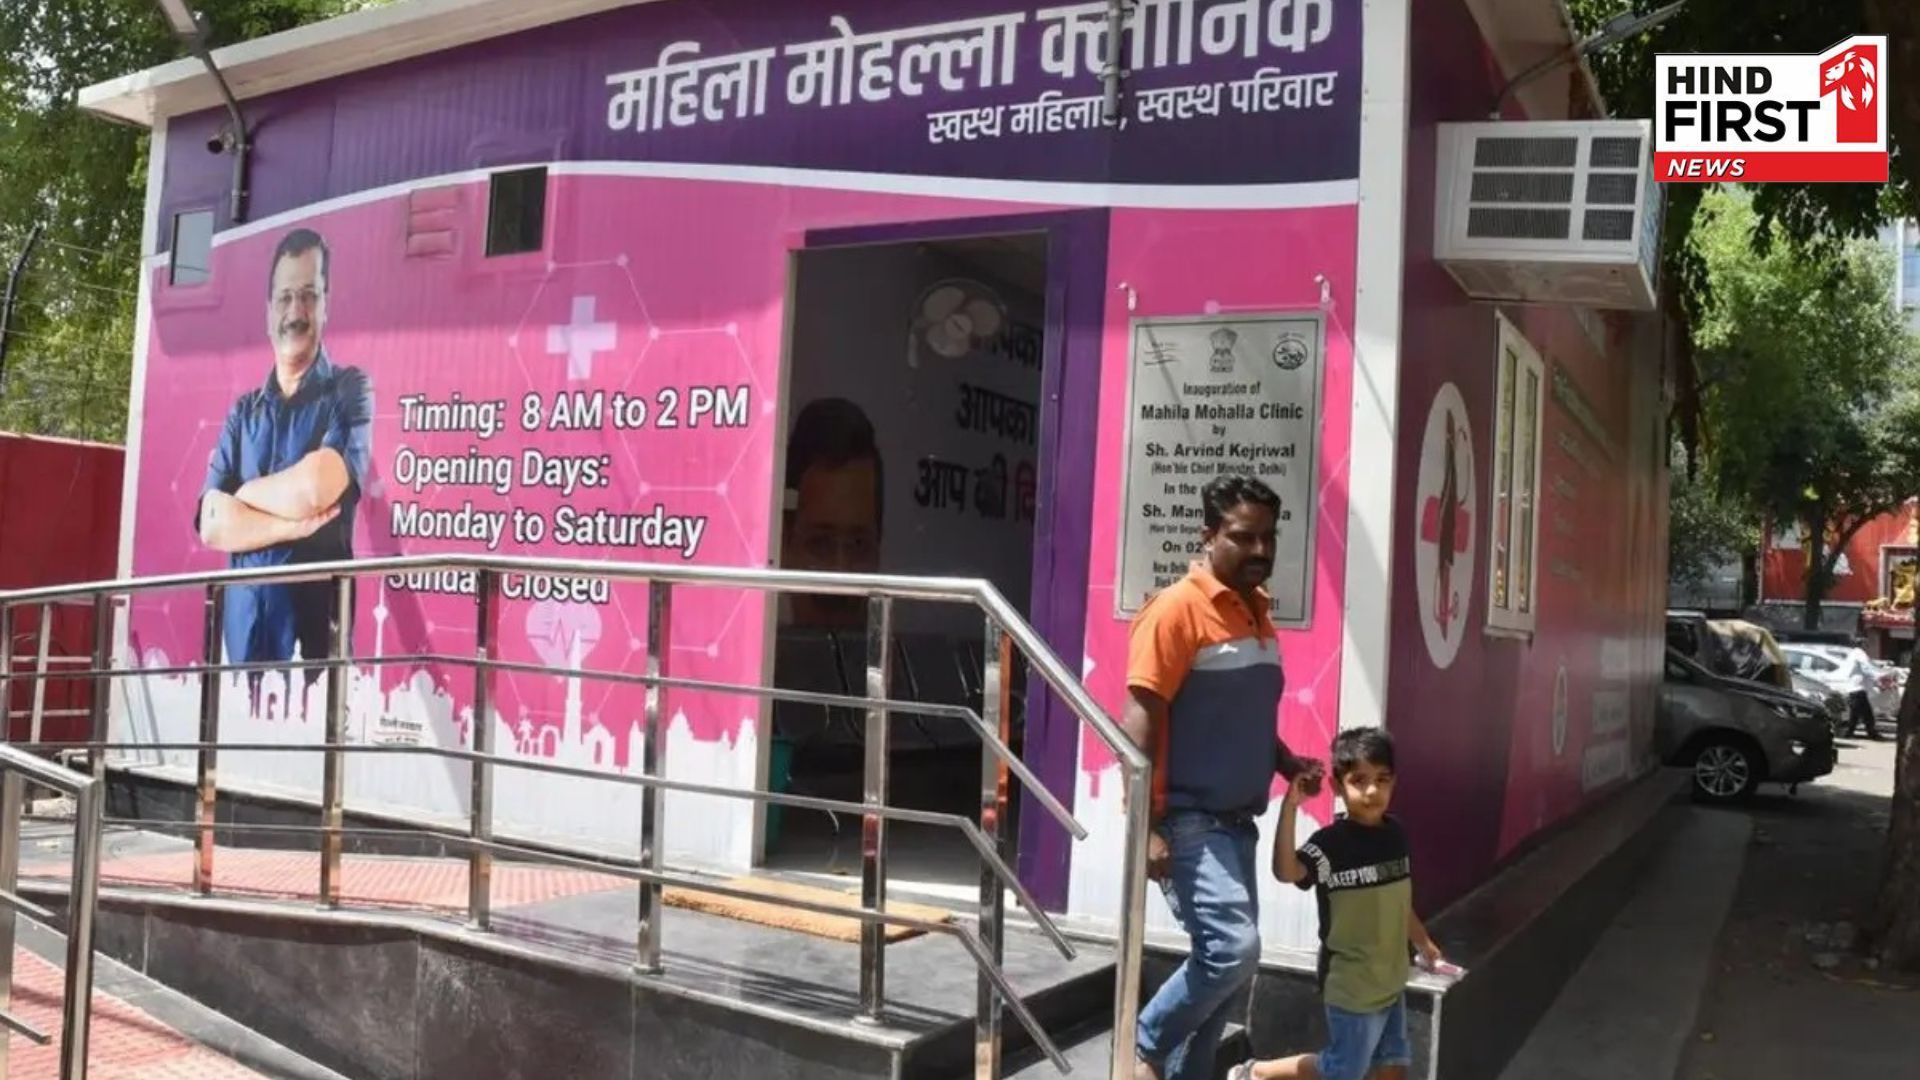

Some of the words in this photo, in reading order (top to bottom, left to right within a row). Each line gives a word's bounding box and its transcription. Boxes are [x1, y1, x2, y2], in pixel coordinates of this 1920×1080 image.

[605, 41, 776, 133] महिला
[785, 12, 1026, 107] मोहल्ला
[927, 107, 1001, 144] स्वस्थ
[1136, 81, 1222, 123] स्वस्थ
[1229, 67, 1338, 113] परिवार
[399, 393, 506, 438] Timing:
[522, 393, 542, 431] 8
[549, 391, 604, 430] AM
[613, 392, 648, 429] to
[656, 388, 679, 428] 2
[689, 386, 749, 427] PM
[1142, 405, 1190, 420] Mahila
[1195, 404, 1255, 420] Mohalla
[1260, 403, 1305, 420] Clinic
[1212, 425, 1226, 437] by
[1145, 443, 1169, 458] Sh.
[1174, 443, 1226, 458] Arvind
[1229, 443, 1296, 461] Kejriwal
[395, 448, 513, 492] Opening
[521, 450, 611, 495] Days:
[1164, 484, 1175, 495] In
[1179, 483, 1197, 495] the
[1142, 505, 1166, 518] Sh.
[1172, 505, 1203, 518] Man
[390, 503, 506, 549] Monday
[513, 508, 544, 542] to
[554, 505, 707, 558] Saturday
[1162, 541, 1182, 553] On
[388, 570, 480, 602] unda
